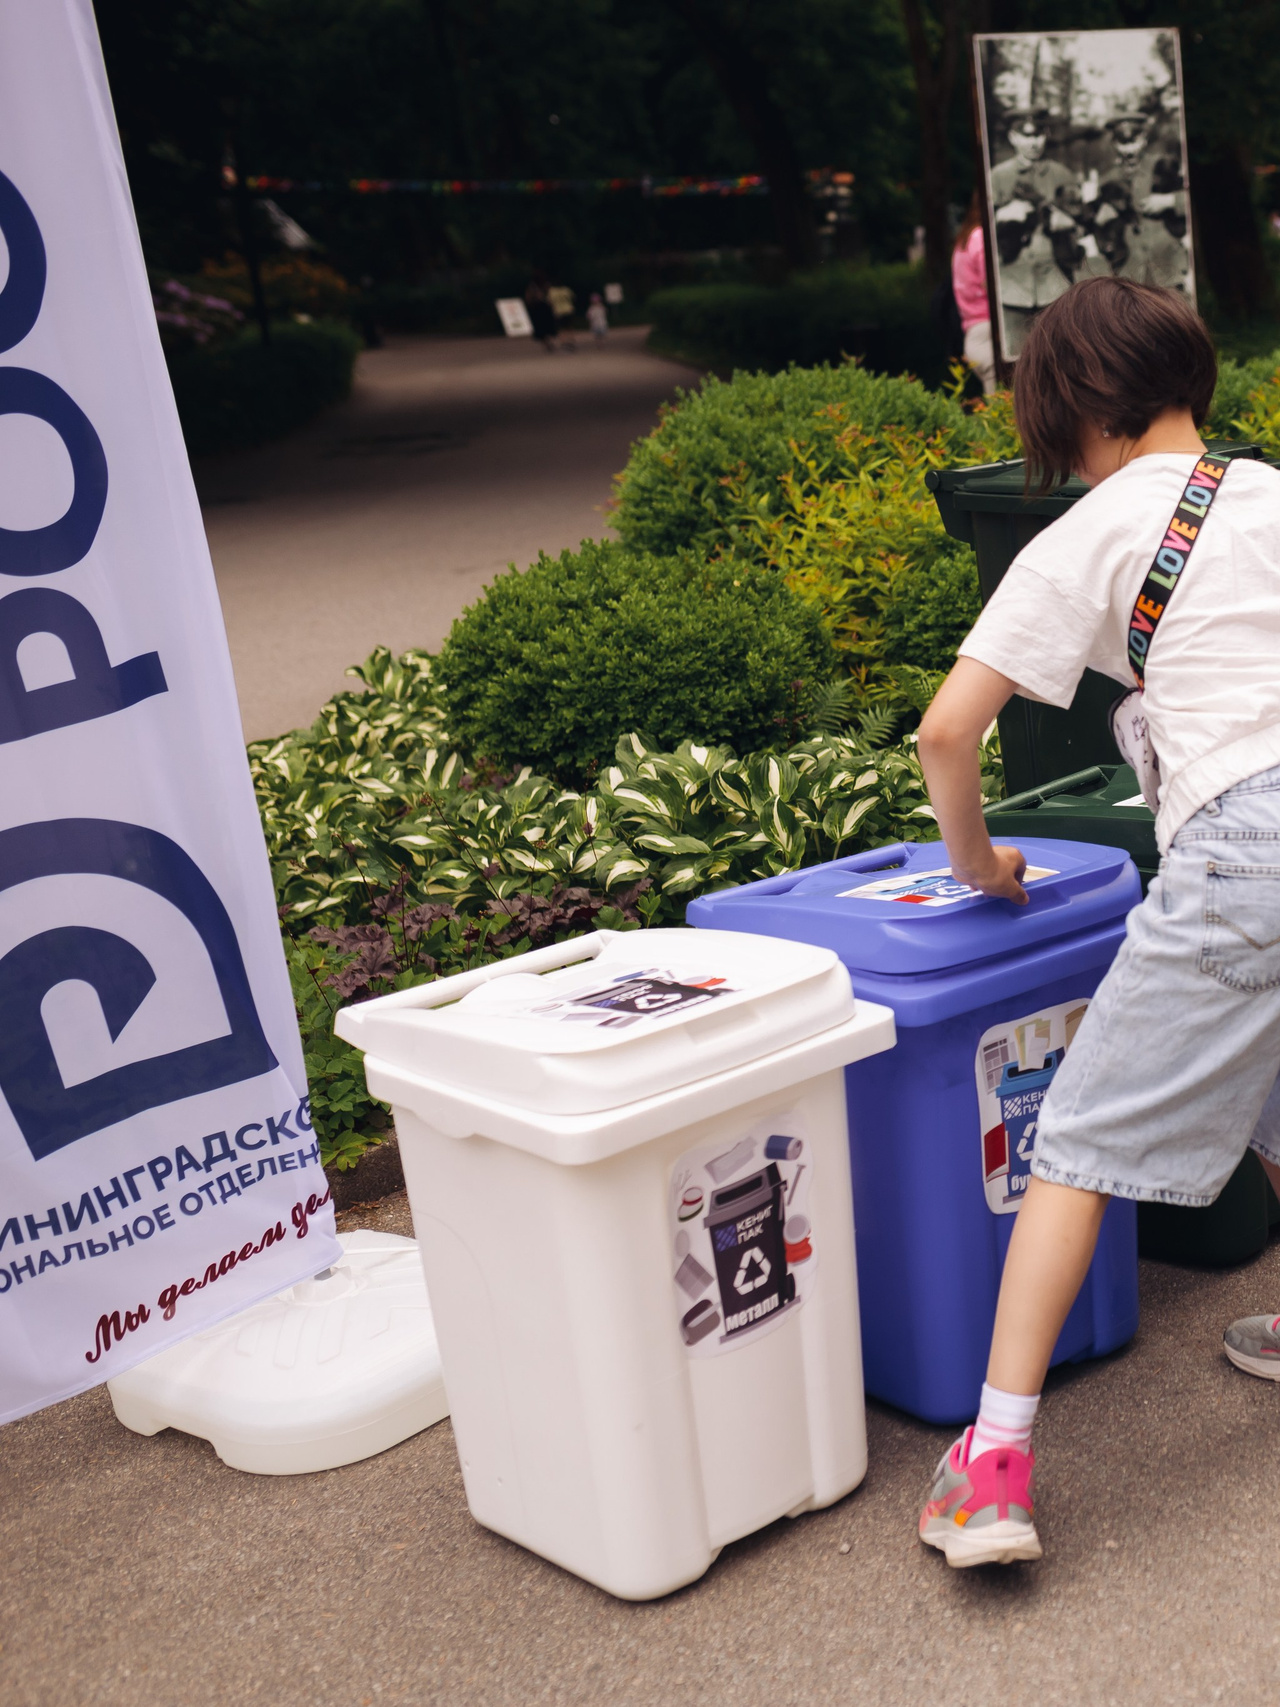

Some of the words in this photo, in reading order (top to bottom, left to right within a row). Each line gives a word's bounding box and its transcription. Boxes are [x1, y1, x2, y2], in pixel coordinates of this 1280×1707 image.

[1179, 461, 1224, 518] LOVE
[1148, 517, 1198, 590] LOVE
[1129, 594, 1164, 668] LOVE
[1023, 1089, 1048, 1104] КЕН
[1023, 1102, 1042, 1116] ПА
[736, 1204, 773, 1233] КЕНИГ
[738, 1223, 764, 1244] ПАК
[86, 1304, 150, 1363] Мы
[157, 1222, 286, 1321] делаем
